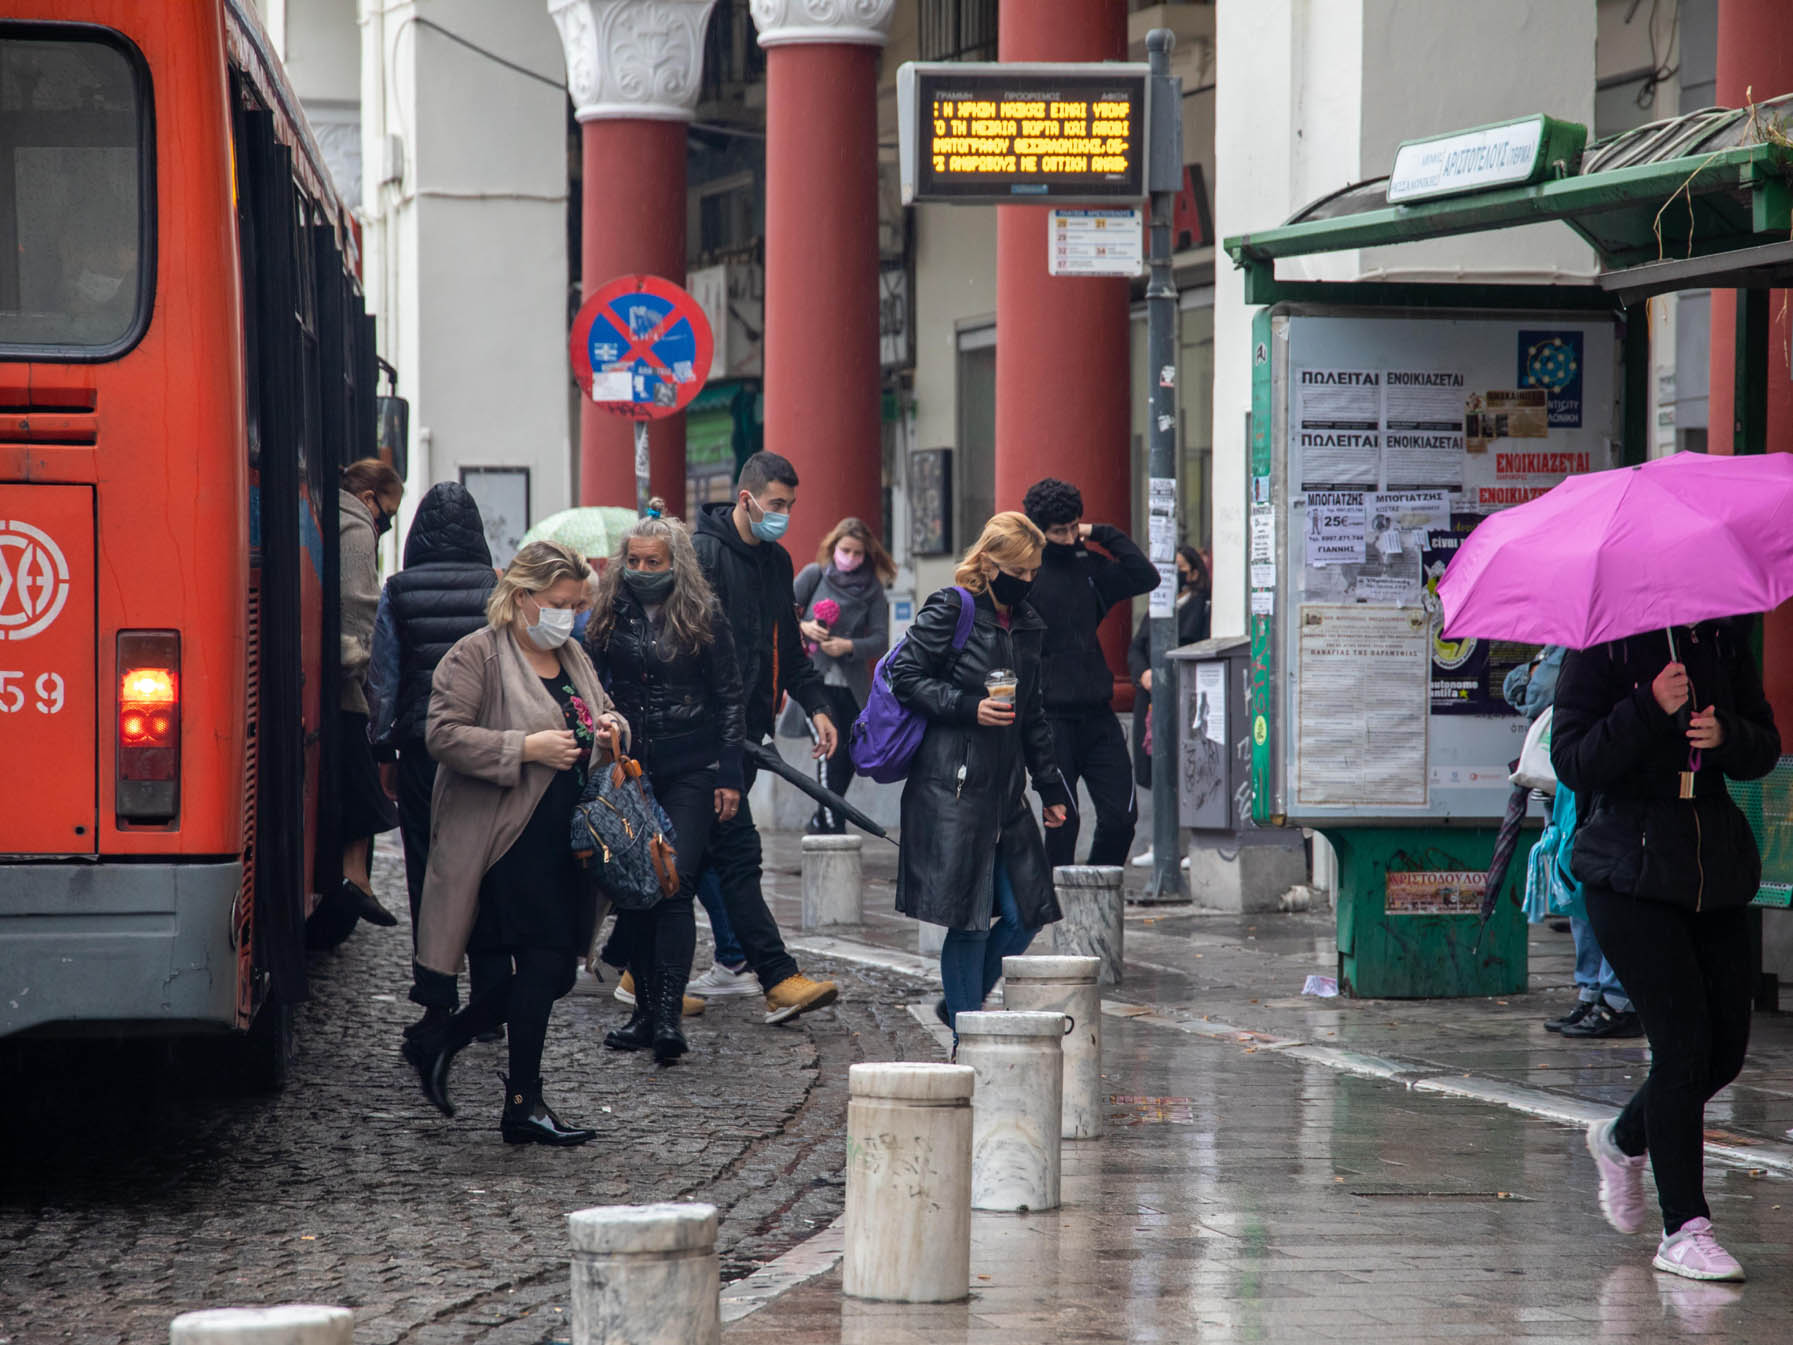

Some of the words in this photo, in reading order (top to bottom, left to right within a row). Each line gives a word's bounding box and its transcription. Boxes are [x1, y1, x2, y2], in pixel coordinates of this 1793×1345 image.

[1050, 101, 1087, 118] ΕΙΝΑΙ
[933, 119, 946, 136] Ο
[950, 120, 967, 136] ΤΗ
[1021, 120, 1060, 136] ΠΟΡΤΑ
[1064, 120, 1087, 136] ΚΑΙ
[1020, 155, 1038, 172] ΜΕ
[1442, 141, 1509, 177] ΑΡΙΣΤΟΤΕΛΟΥΣ
[1302, 371, 1379, 386] ΠΩΛΕΙΤΑΙ
[1387, 372, 1464, 387] ΕΝΟΙΚΙΑΖΕΤΑΙ
[1301, 434, 1379, 448] ΠΩΛΕΙΤΑΙ
[1387, 435, 1464, 449] ΕΝΟΙΚΙΑΖΕΤΑΙ
[1496, 452, 1590, 473] ΕΝΟΙΚΙΑΖΕΤΑΙ
[1308, 493, 1364, 506] ΜΠΟΓΙΑΤΖΗΣ
[1376, 492, 1443, 503] ΜΠΟΓΙΑΤΖΗΣ
[1479, 487, 1554, 504] ΕΝΟΙΚΙΑΖΕ
[1324, 516, 1349, 528] 25€
